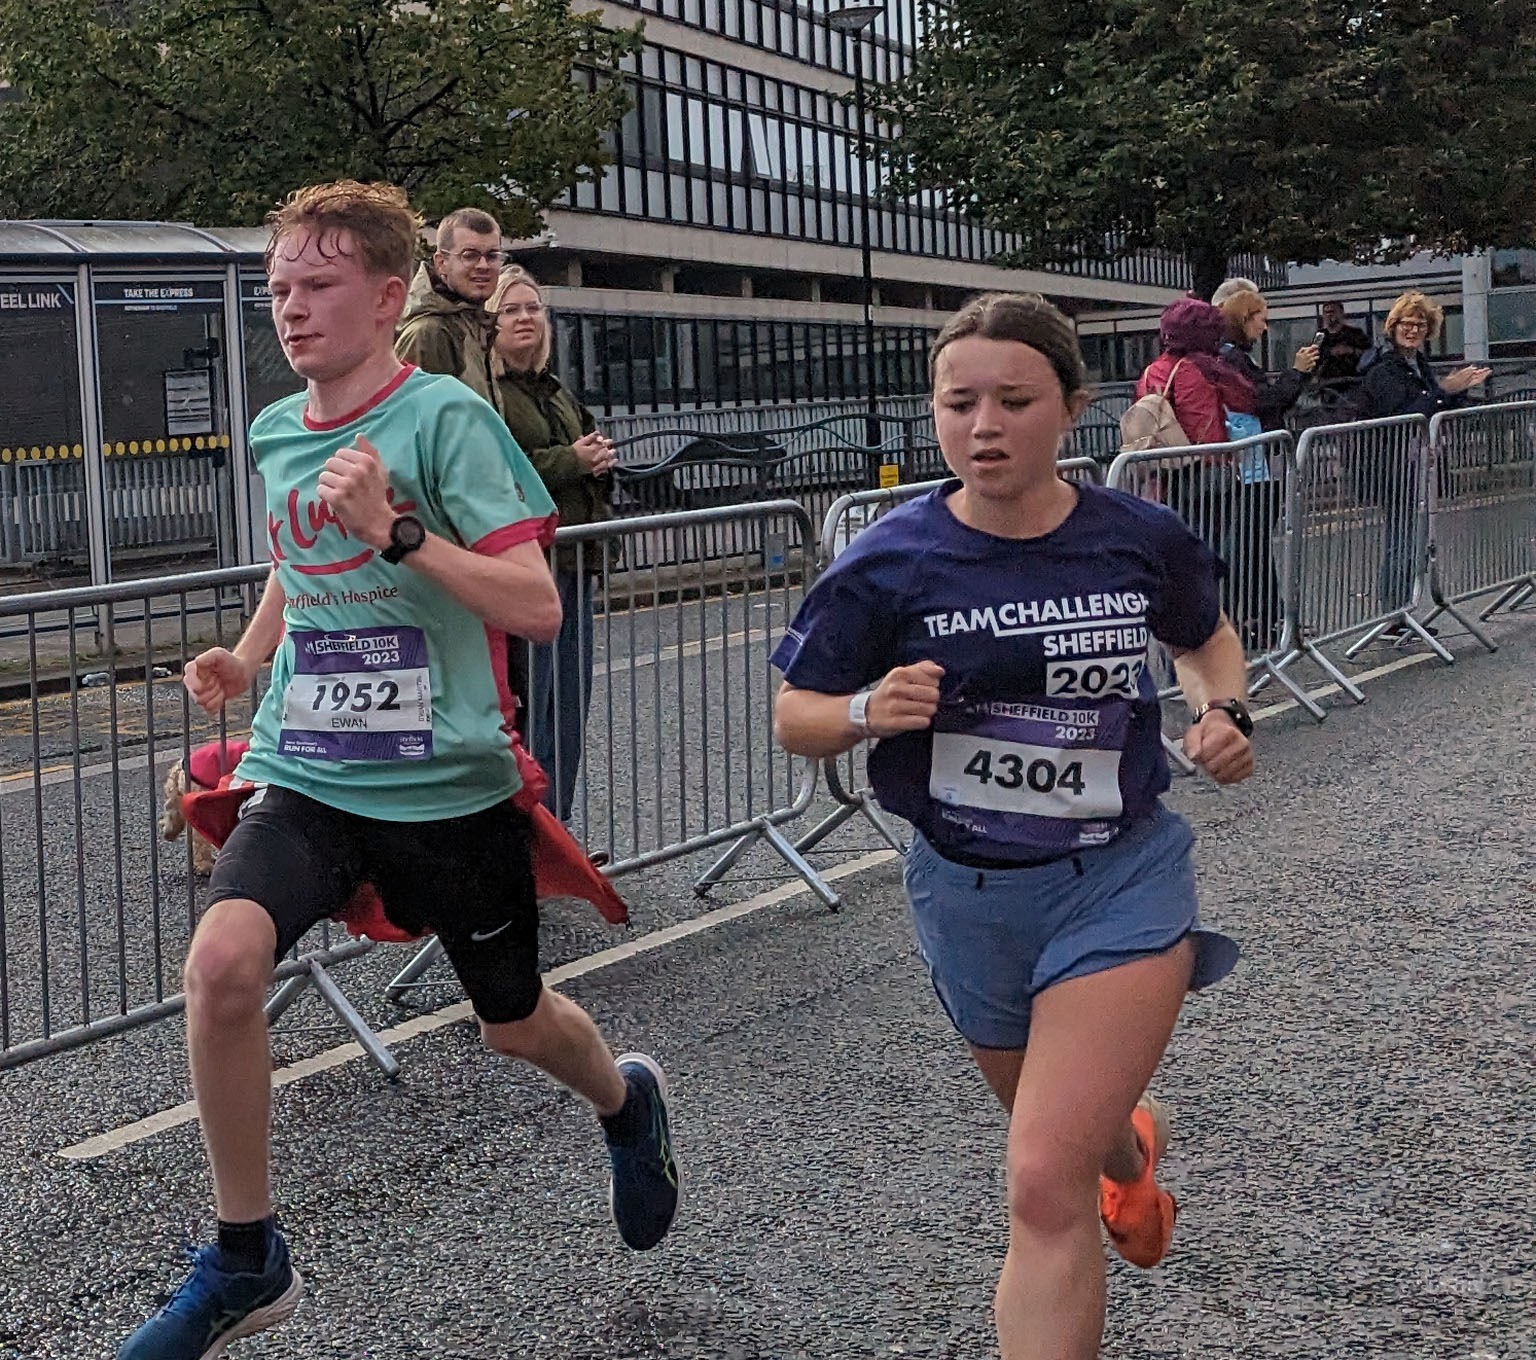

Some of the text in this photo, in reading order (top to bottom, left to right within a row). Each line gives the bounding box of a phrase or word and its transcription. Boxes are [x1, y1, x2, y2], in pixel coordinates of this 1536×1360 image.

[124, 287, 194, 298] TAKE THE EXPRESS
[341, 586, 398, 606] Hospice
[317, 636, 397, 652] SHEFFIELD 10K
[1043, 626, 1148, 657] SHEFFIELD
[362, 650, 400, 665] 2023
[992, 703, 1097, 725] SHEFFIELD 10K
[331, 717, 368, 729] EWAN
[1055, 726, 1096, 741] 2023
[284, 744, 327, 754] RUN FOR ALL
[964, 749, 1086, 796] 4304
